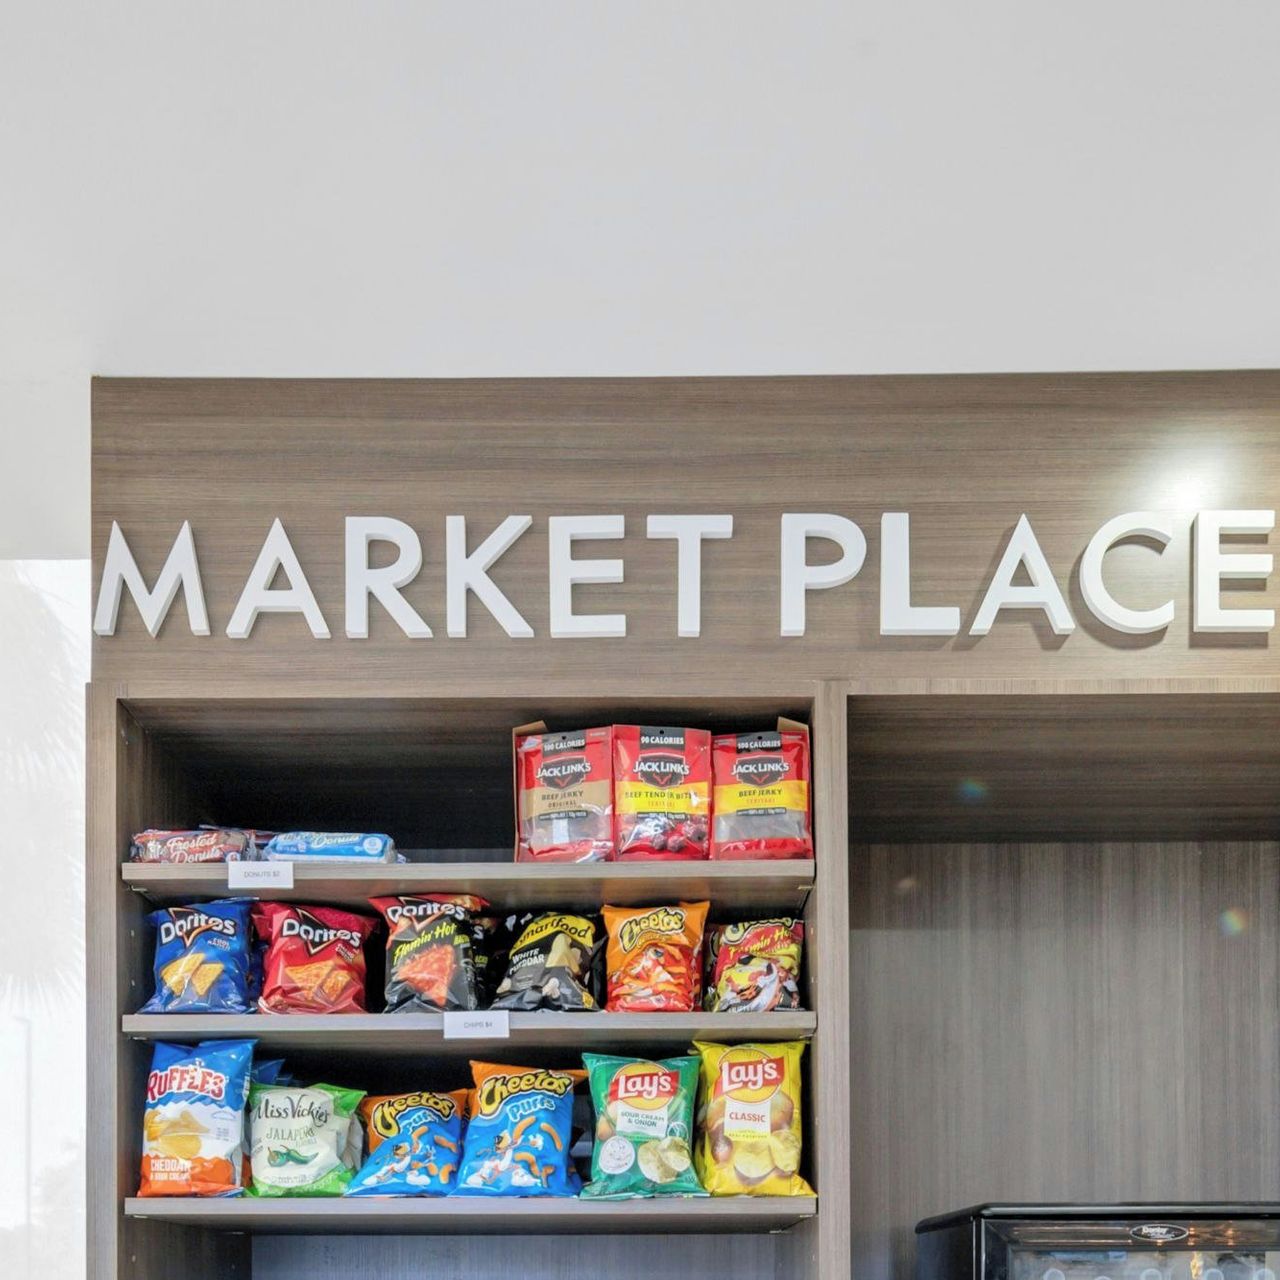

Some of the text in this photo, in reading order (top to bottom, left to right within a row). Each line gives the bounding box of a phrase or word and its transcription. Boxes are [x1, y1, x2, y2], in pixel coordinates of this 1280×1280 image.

[94, 508, 1277, 639] MARKET PLACE
[555, 739, 585, 750] CALORIES
[651, 736, 684, 745] CALORIES
[749, 739, 781, 749] CALORIES
[536, 765, 561, 779] JACK
[633, 761, 660, 773] JACK
[731, 763, 757, 776] JACK
[738, 788, 782, 798] BEEF JERKY
[166, 833, 219, 853] Frosted
[387, 902, 466, 923] Doritos
[160, 914, 236, 945] Doritos
[282, 918, 362, 947] Doritos
[434, 921, 458, 939] Hot
[620, 906, 686, 953] Cheetos
[512, 948, 540, 964] WHITE
[721, 1059, 780, 1090] Lay's
[479, 1069, 574, 1119] Cheetos
[618, 1072, 672, 1099] Lay's
[372, 1092, 457, 1138] Cheetos
[621, 1111, 665, 1122] SOUR CREAM
[634, 1118, 657, 1128] ONION
[729, 1112, 766, 1123] CLASSIC
